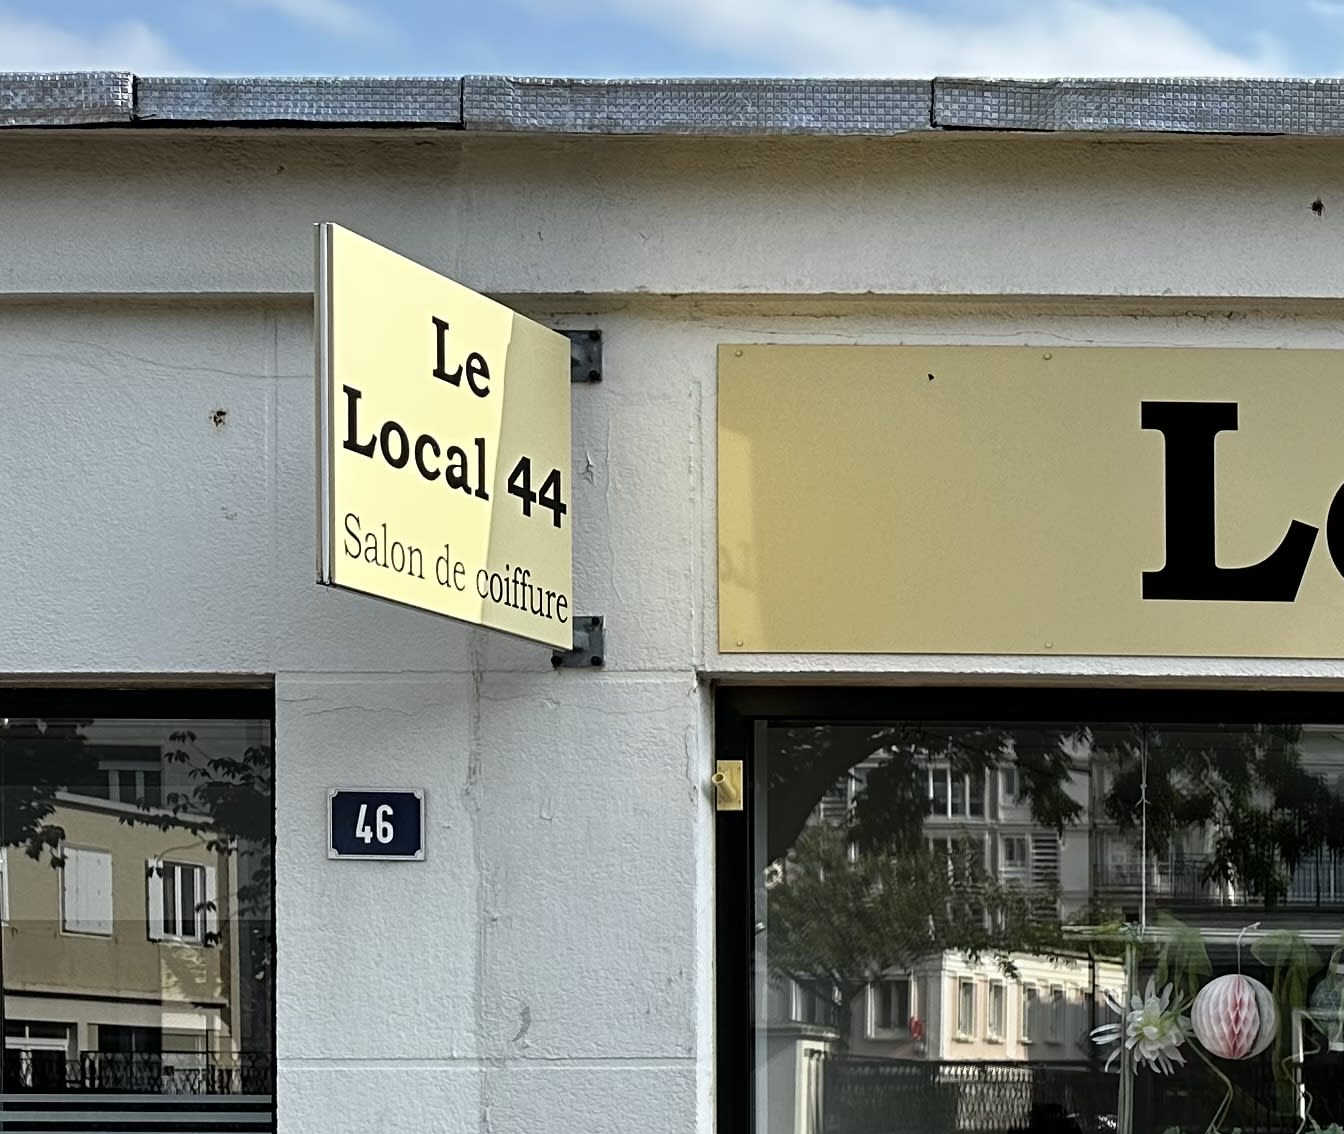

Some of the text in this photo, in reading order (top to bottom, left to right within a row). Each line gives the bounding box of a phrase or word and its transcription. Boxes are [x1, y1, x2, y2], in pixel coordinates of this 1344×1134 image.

[433, 316, 490, 398] Le
[343, 384, 567, 529] Local 44
[344, 513, 569, 624] Salon de coiffure
[355, 804, 394, 844] 46
